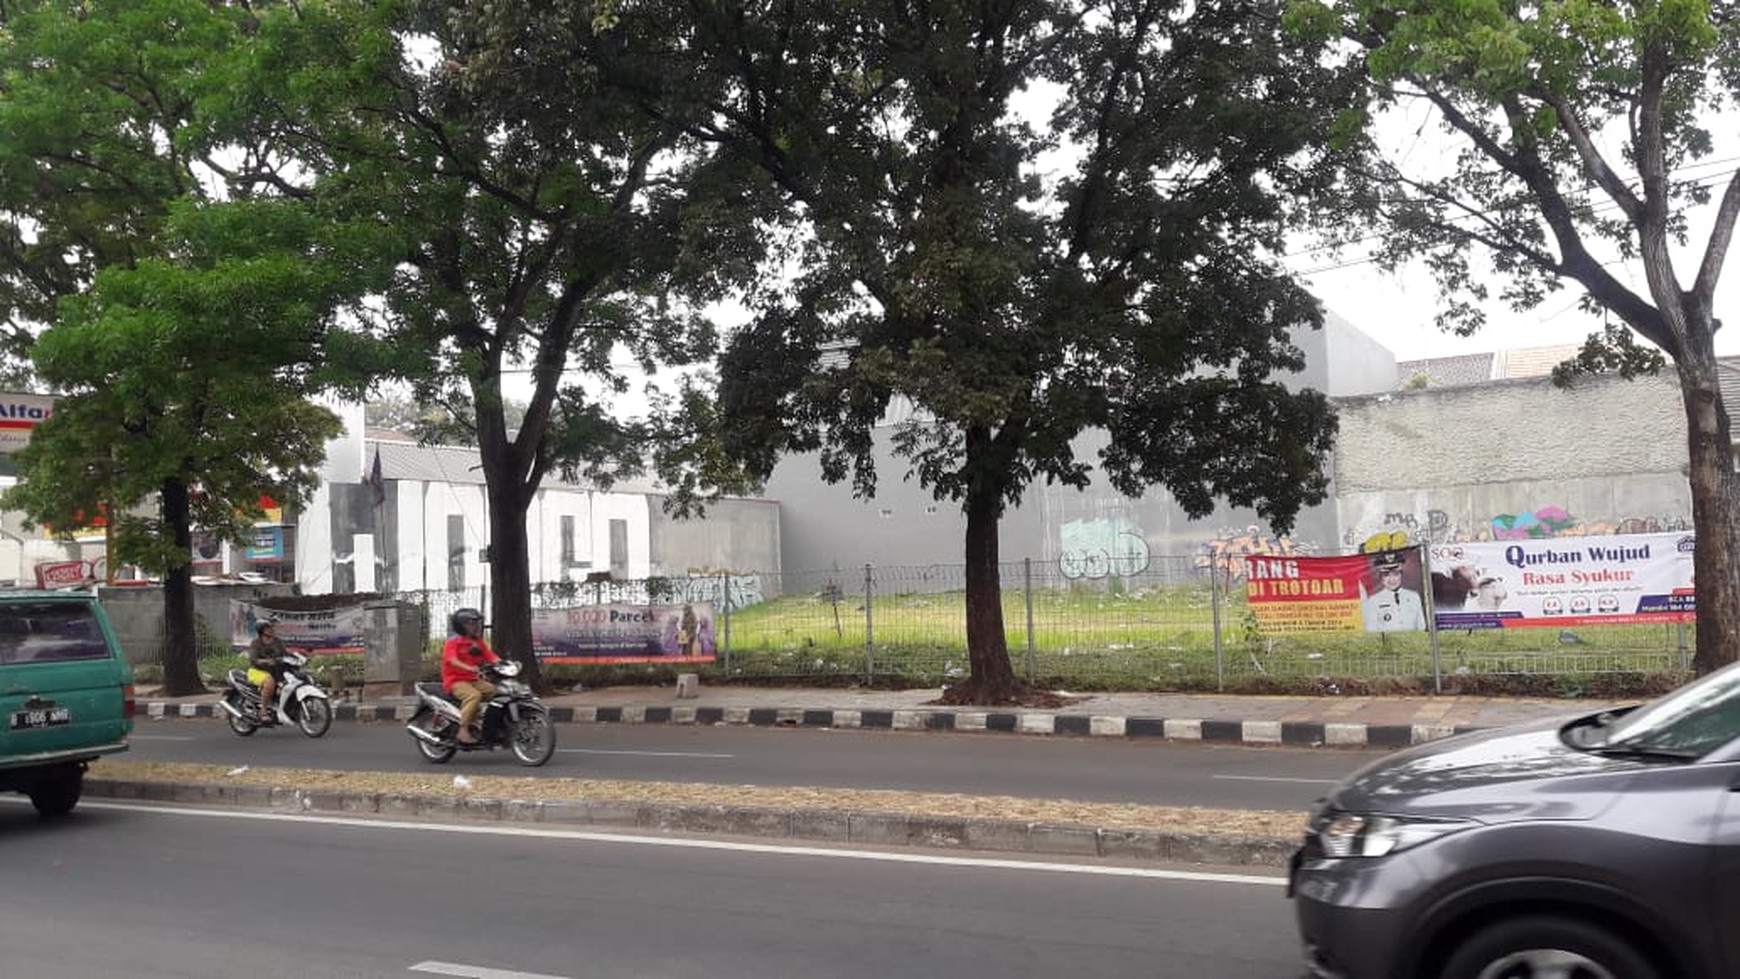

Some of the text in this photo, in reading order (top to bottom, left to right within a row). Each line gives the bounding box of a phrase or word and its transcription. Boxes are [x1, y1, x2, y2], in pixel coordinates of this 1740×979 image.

[1505, 544, 1650, 568] Qurban Wujud
[1523, 568, 1634, 586] Rasa Syukur
[1269, 579, 1344, 595] TROTOAR
